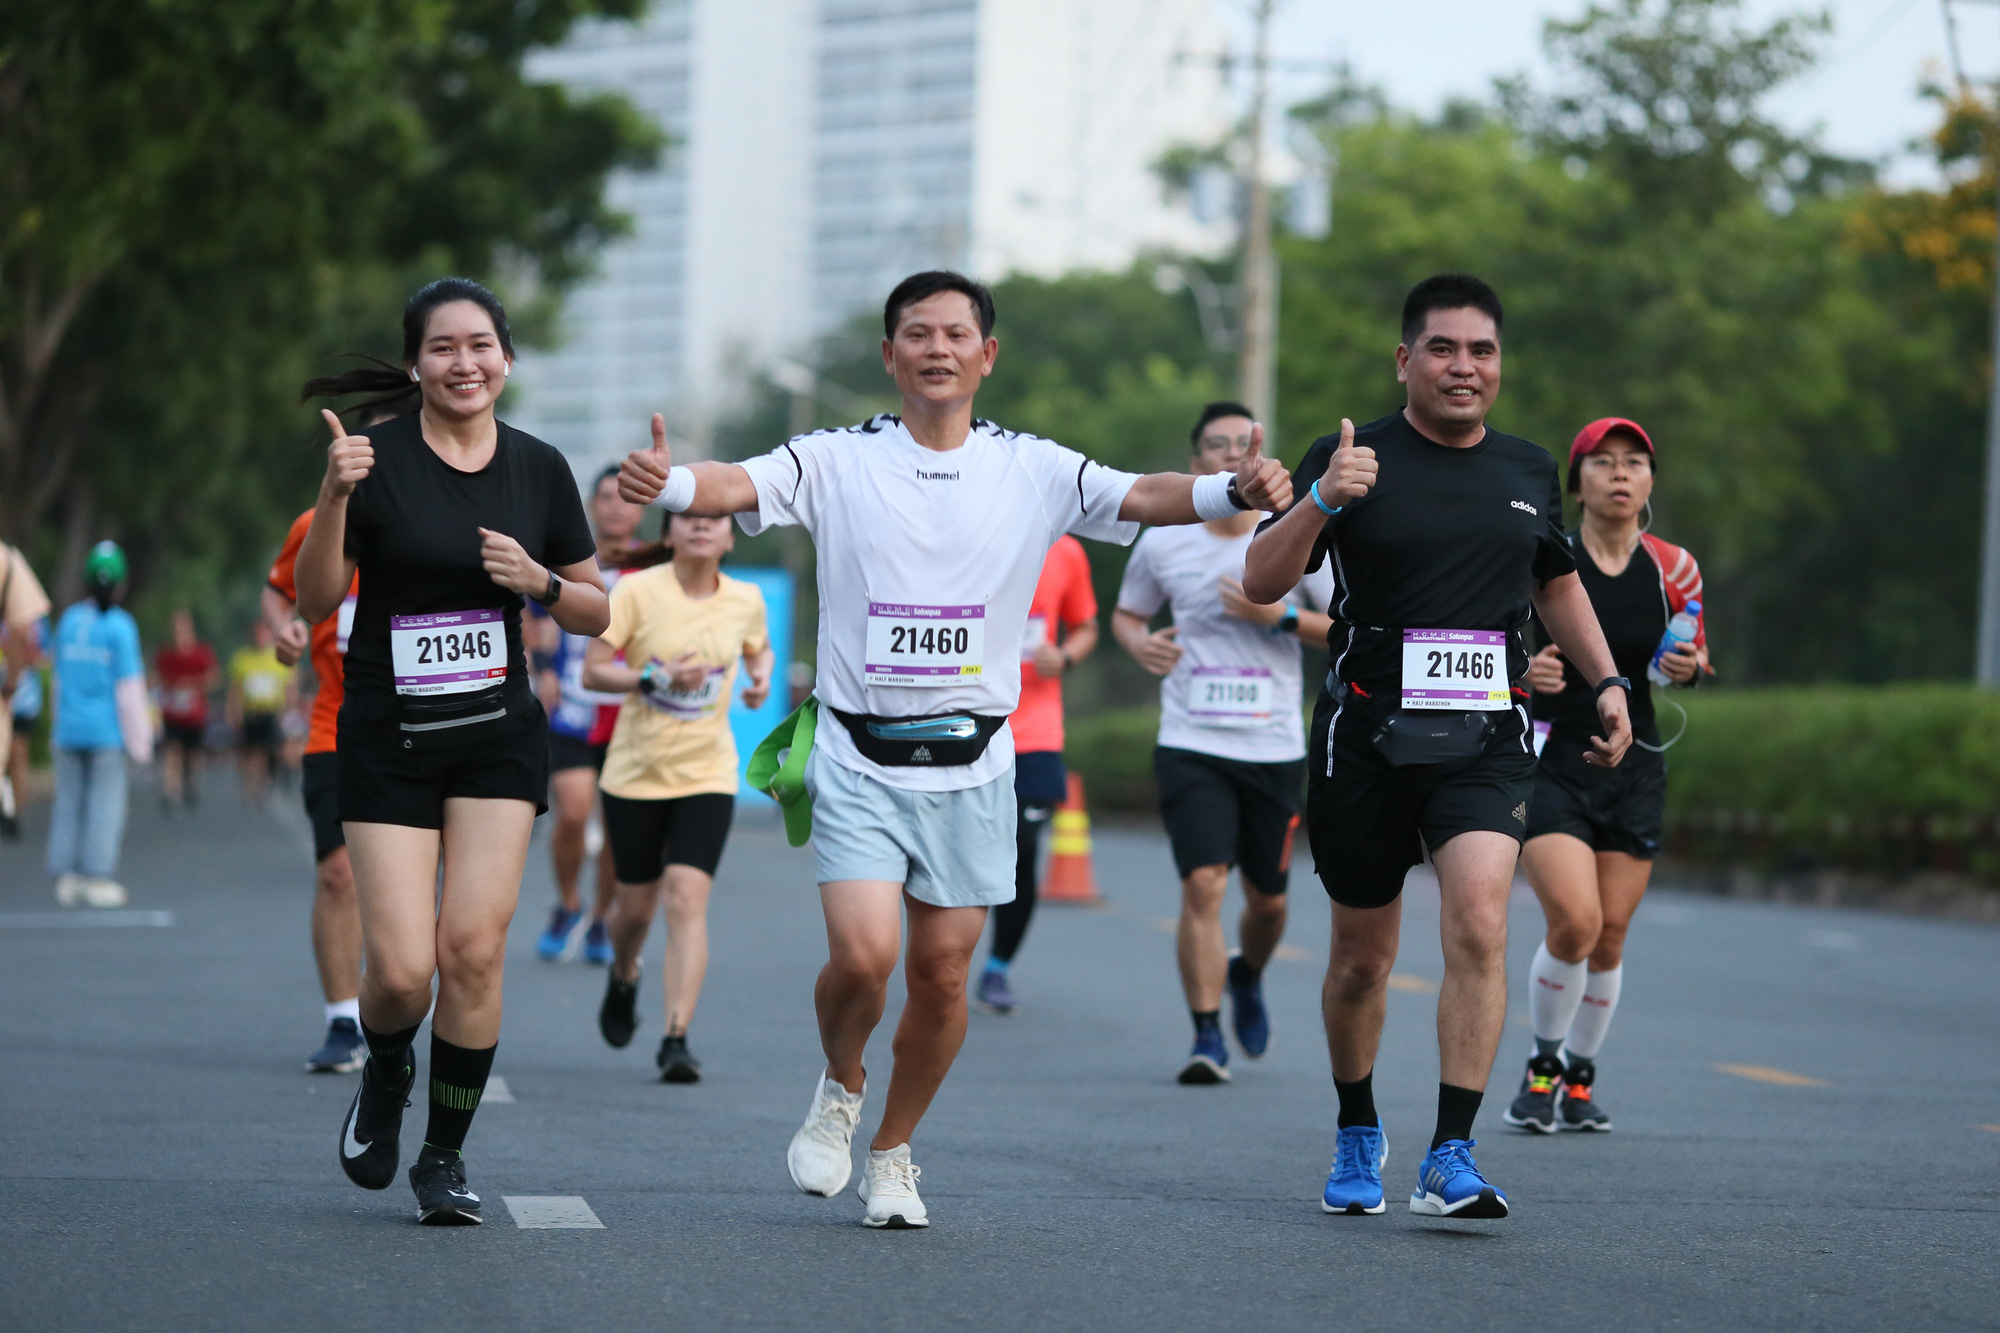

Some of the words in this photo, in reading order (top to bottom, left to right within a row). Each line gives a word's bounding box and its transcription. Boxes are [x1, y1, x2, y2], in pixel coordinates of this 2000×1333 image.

[916, 468, 960, 480] hummel
[1510, 500, 1538, 516] adidas
[913, 607, 942, 617] Salonpas
[961, 608, 972, 616] 2021
[435, 615, 462, 624] Salonpas
[890, 626, 969, 654] 21460
[1448, 632, 1475, 642] Salonpas
[416, 630, 492, 664] 21346
[1426, 650, 1495, 680] 21466
[1206, 682, 1259, 702] 21100
